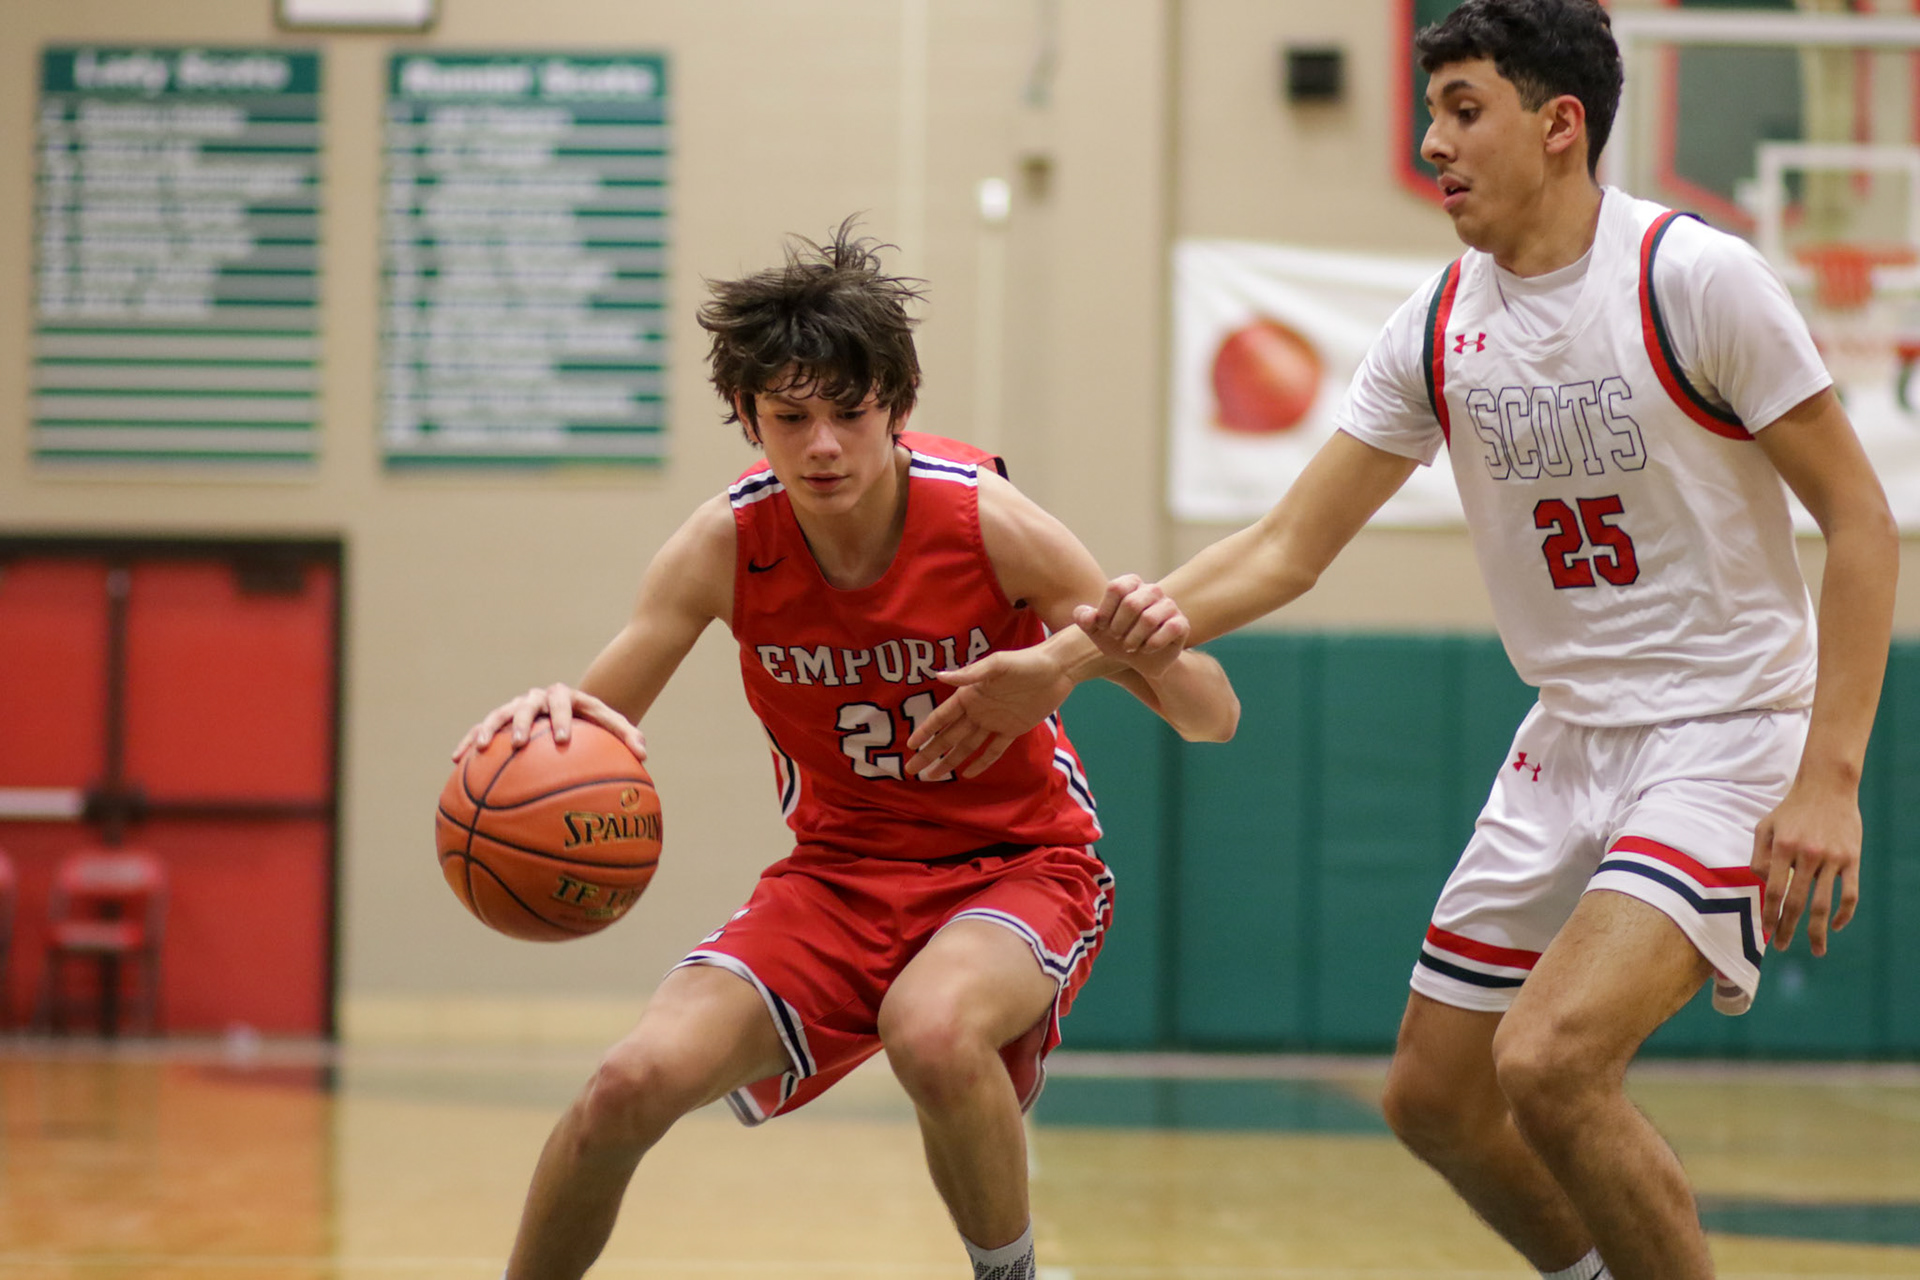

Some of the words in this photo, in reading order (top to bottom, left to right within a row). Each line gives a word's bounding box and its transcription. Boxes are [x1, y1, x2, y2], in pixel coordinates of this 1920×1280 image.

[1466, 375, 1647, 480] SCOTS
[1533, 494, 1640, 589] 25
[757, 626, 991, 686] EMPORIA
[834, 690, 957, 781] 21
